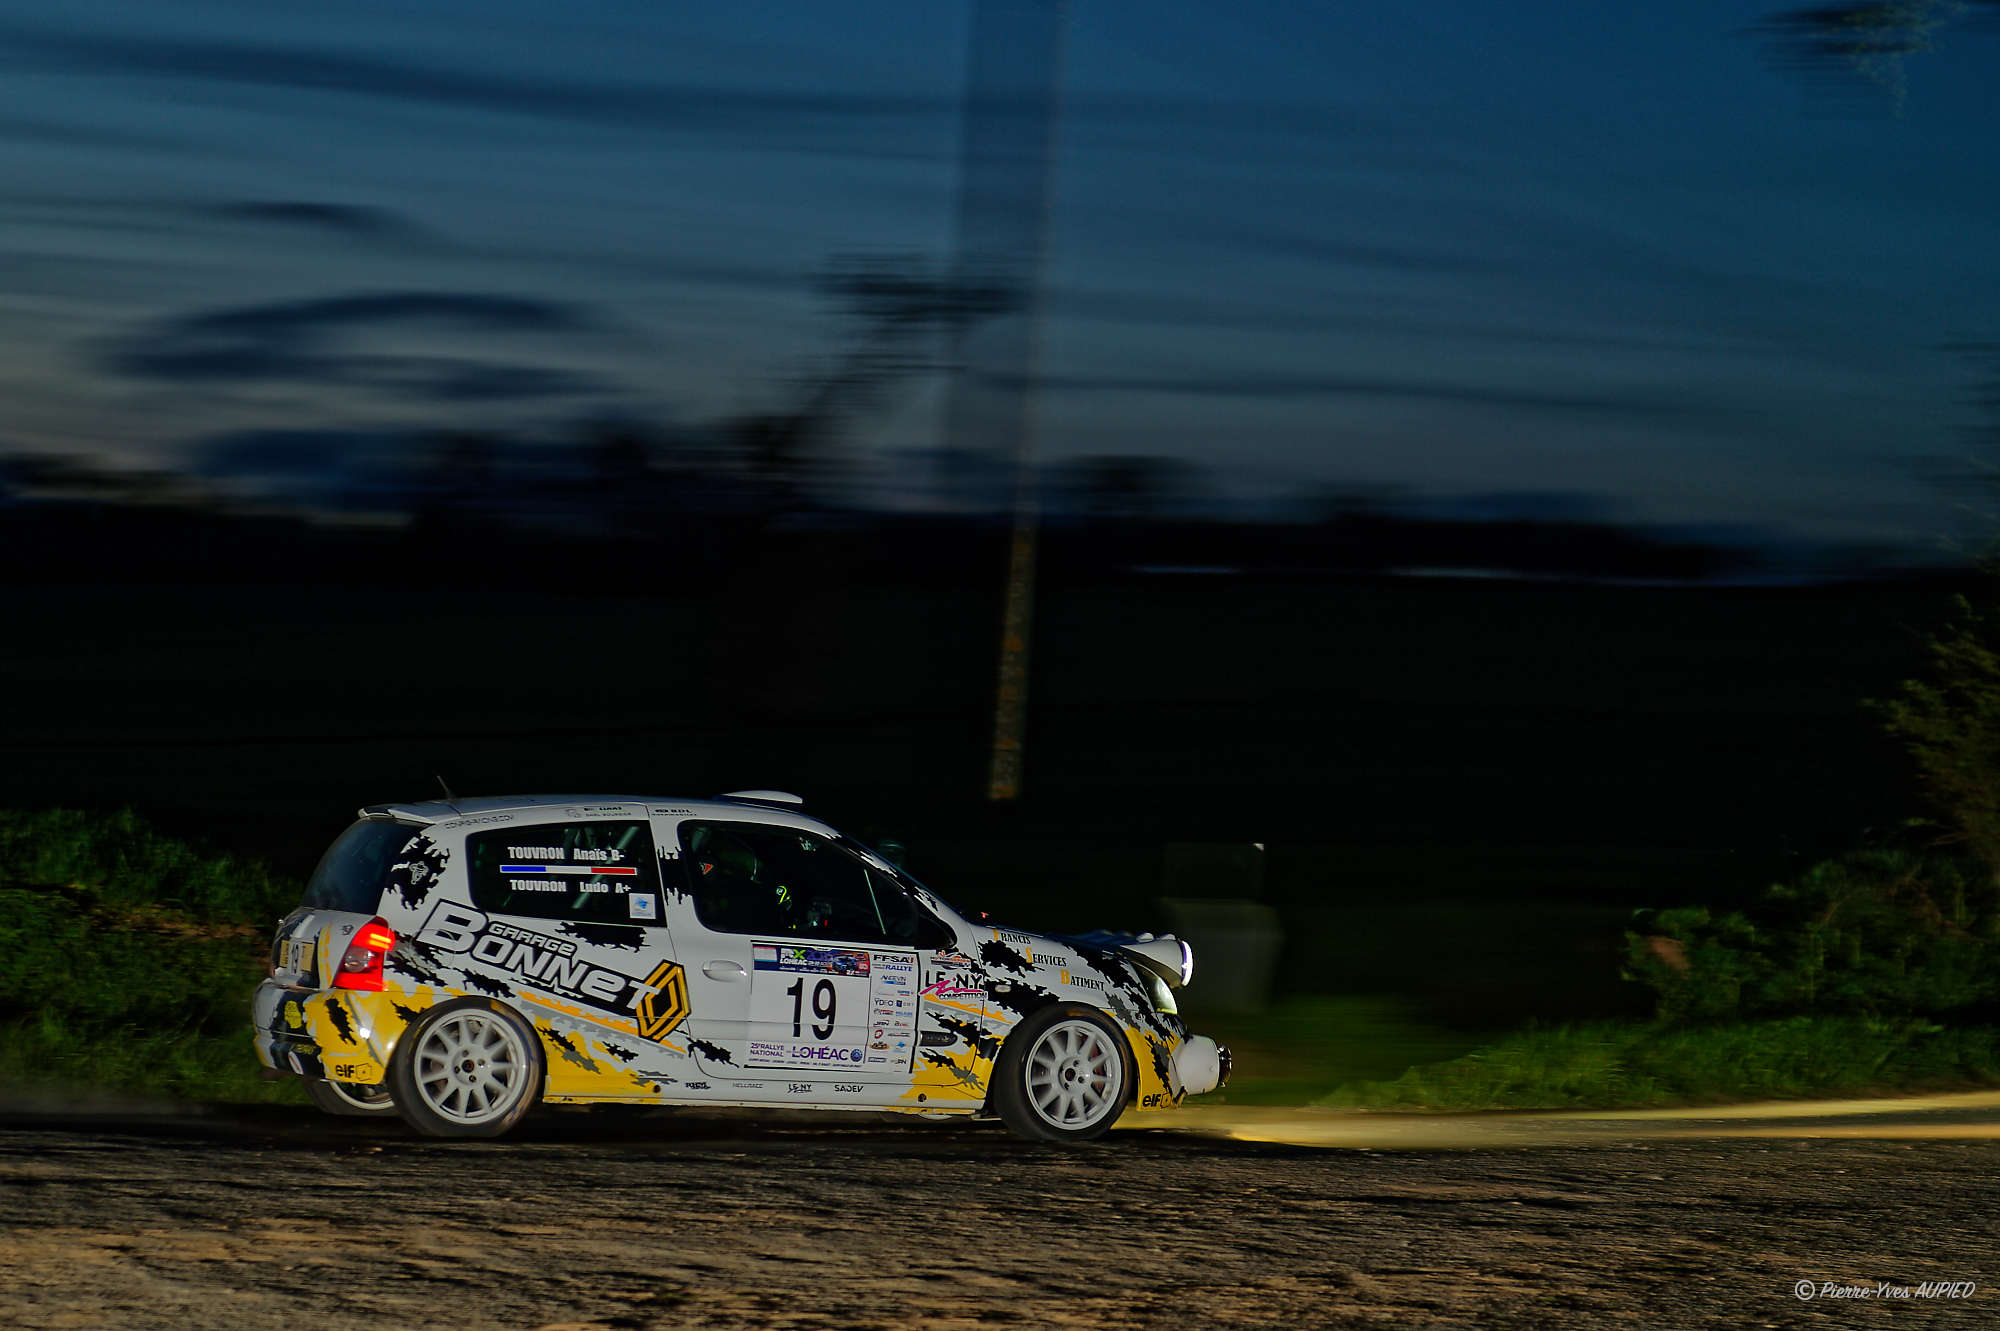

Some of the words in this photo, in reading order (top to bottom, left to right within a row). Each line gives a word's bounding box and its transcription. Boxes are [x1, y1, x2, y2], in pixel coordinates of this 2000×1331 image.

[507, 846, 565, 860] TOUVRON
[573, 848, 607, 861] Anaïs
[611, 850, 625, 861] B-
[510, 879, 567, 892] TOUVRON
[579, 881, 609, 893] Ludo
[615, 883, 632, 894] A+
[874, 955, 909, 963] FFSA
[1025, 946, 1067, 967] SERVICES
[1061, 969, 1105, 991] BATIMENT
[787, 977, 837, 1040] 19
[750, 1049, 784, 1057] NATIONAL
[760, 1043, 785, 1051] RALLYE
[792, 1044, 849, 1061] LOHÉAC
[335, 1064, 355, 1078] elf
[834, 1084, 864, 1093] SADEV
[1142, 1093, 1161, 1107] elf
